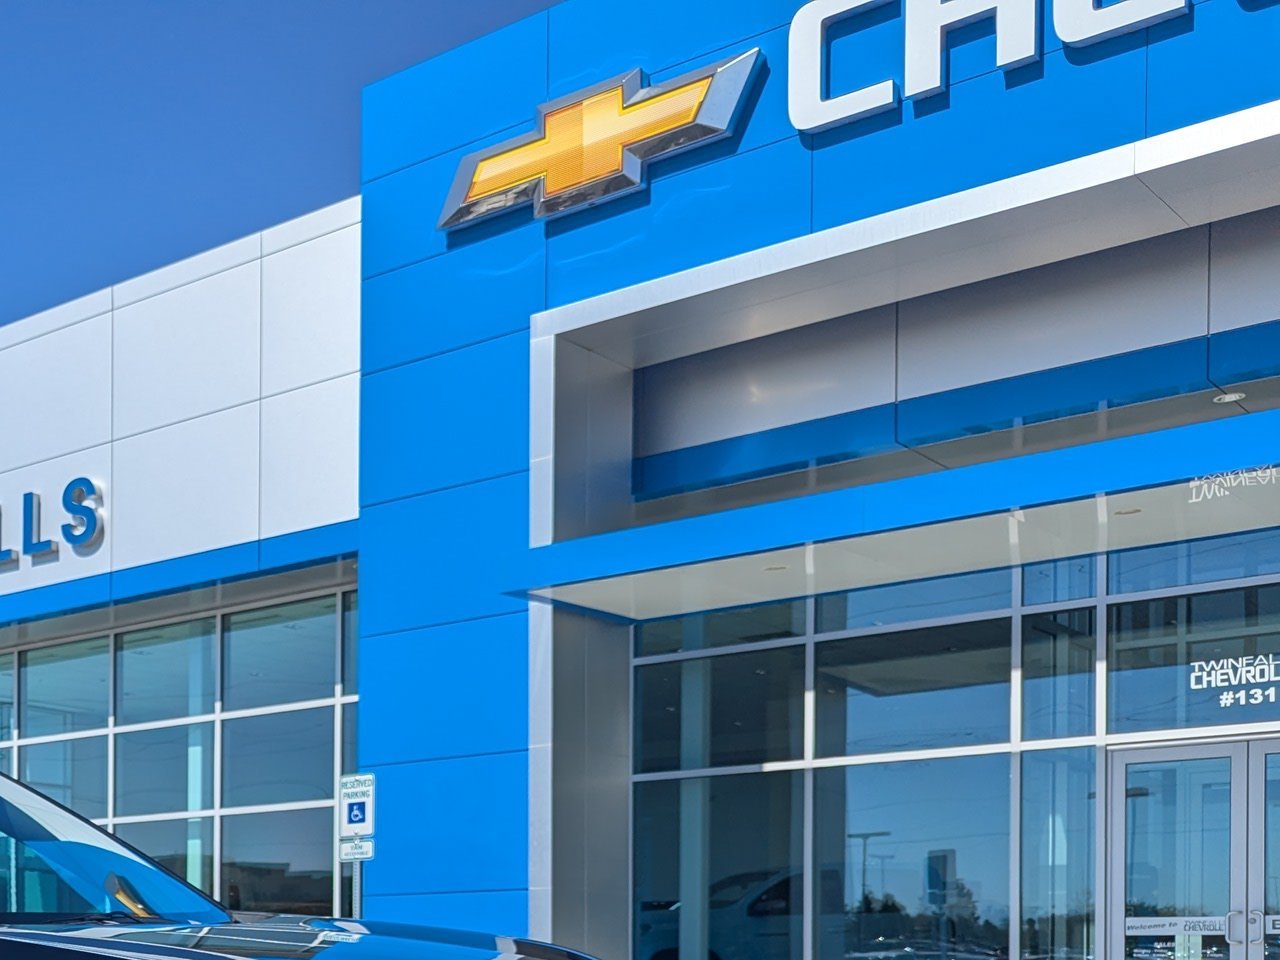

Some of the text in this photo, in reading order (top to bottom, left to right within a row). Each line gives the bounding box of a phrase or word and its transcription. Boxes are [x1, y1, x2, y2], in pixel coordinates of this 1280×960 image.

[1190, 654, 1280, 672] TWINFAL
[1190, 664, 1280, 689] CHEVROL
[341, 779, 372, 790] RESERVED
[343, 790, 370, 800] PARKING
[1127, 923, 1166, 931] Welcome
